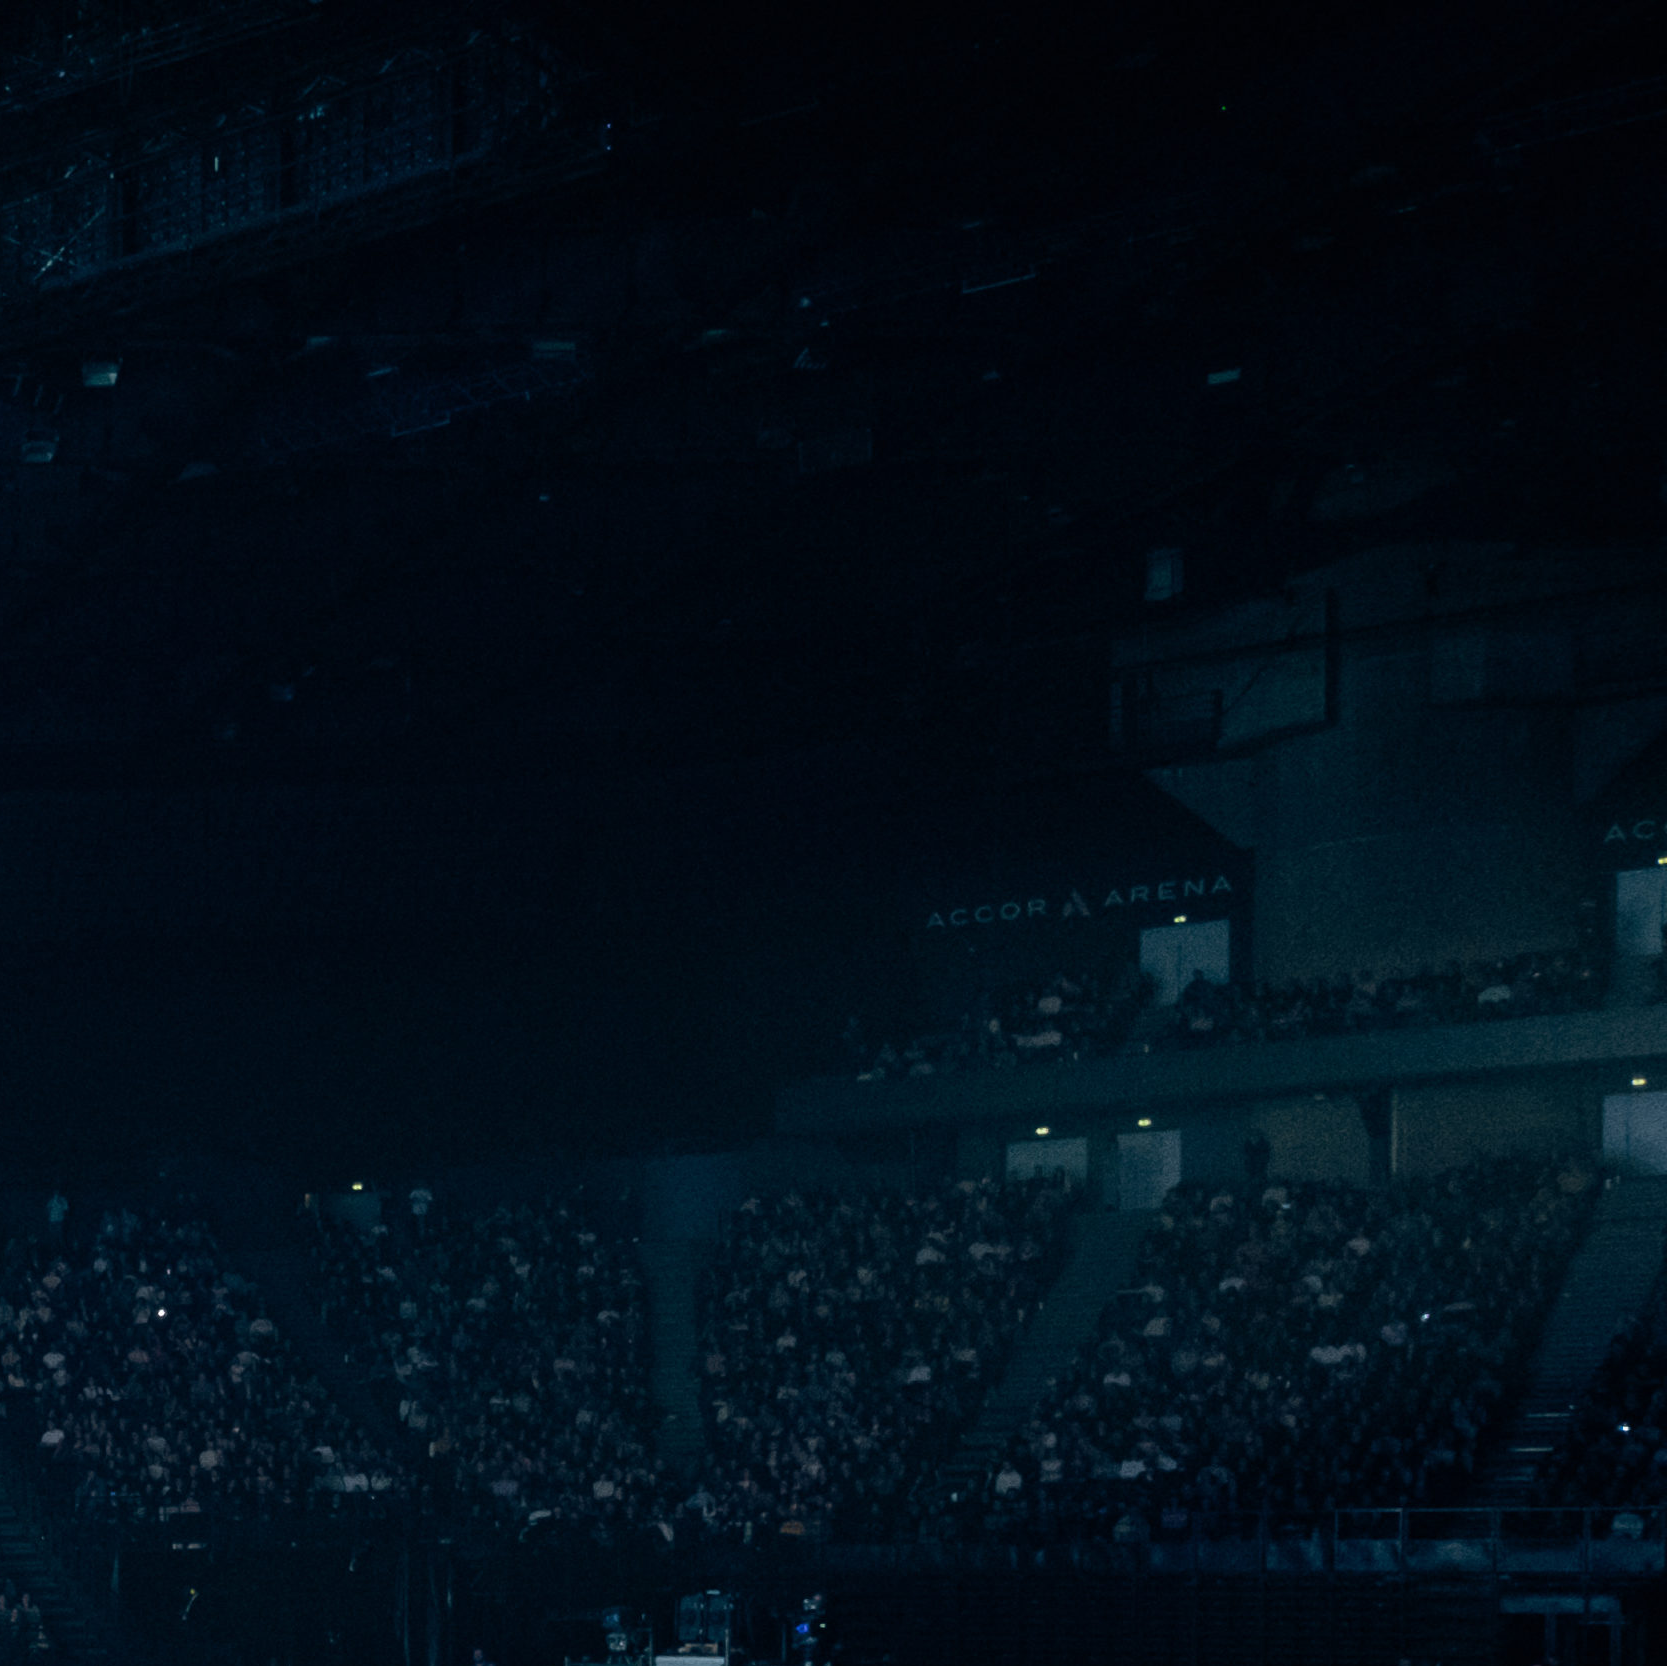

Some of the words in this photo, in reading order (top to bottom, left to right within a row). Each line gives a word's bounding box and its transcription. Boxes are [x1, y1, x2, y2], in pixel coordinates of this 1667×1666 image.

[1604, 820, 1667, 842] AC
[926, 898, 1047, 928] ACCOR
[1104, 875, 1233, 907] ARENA
